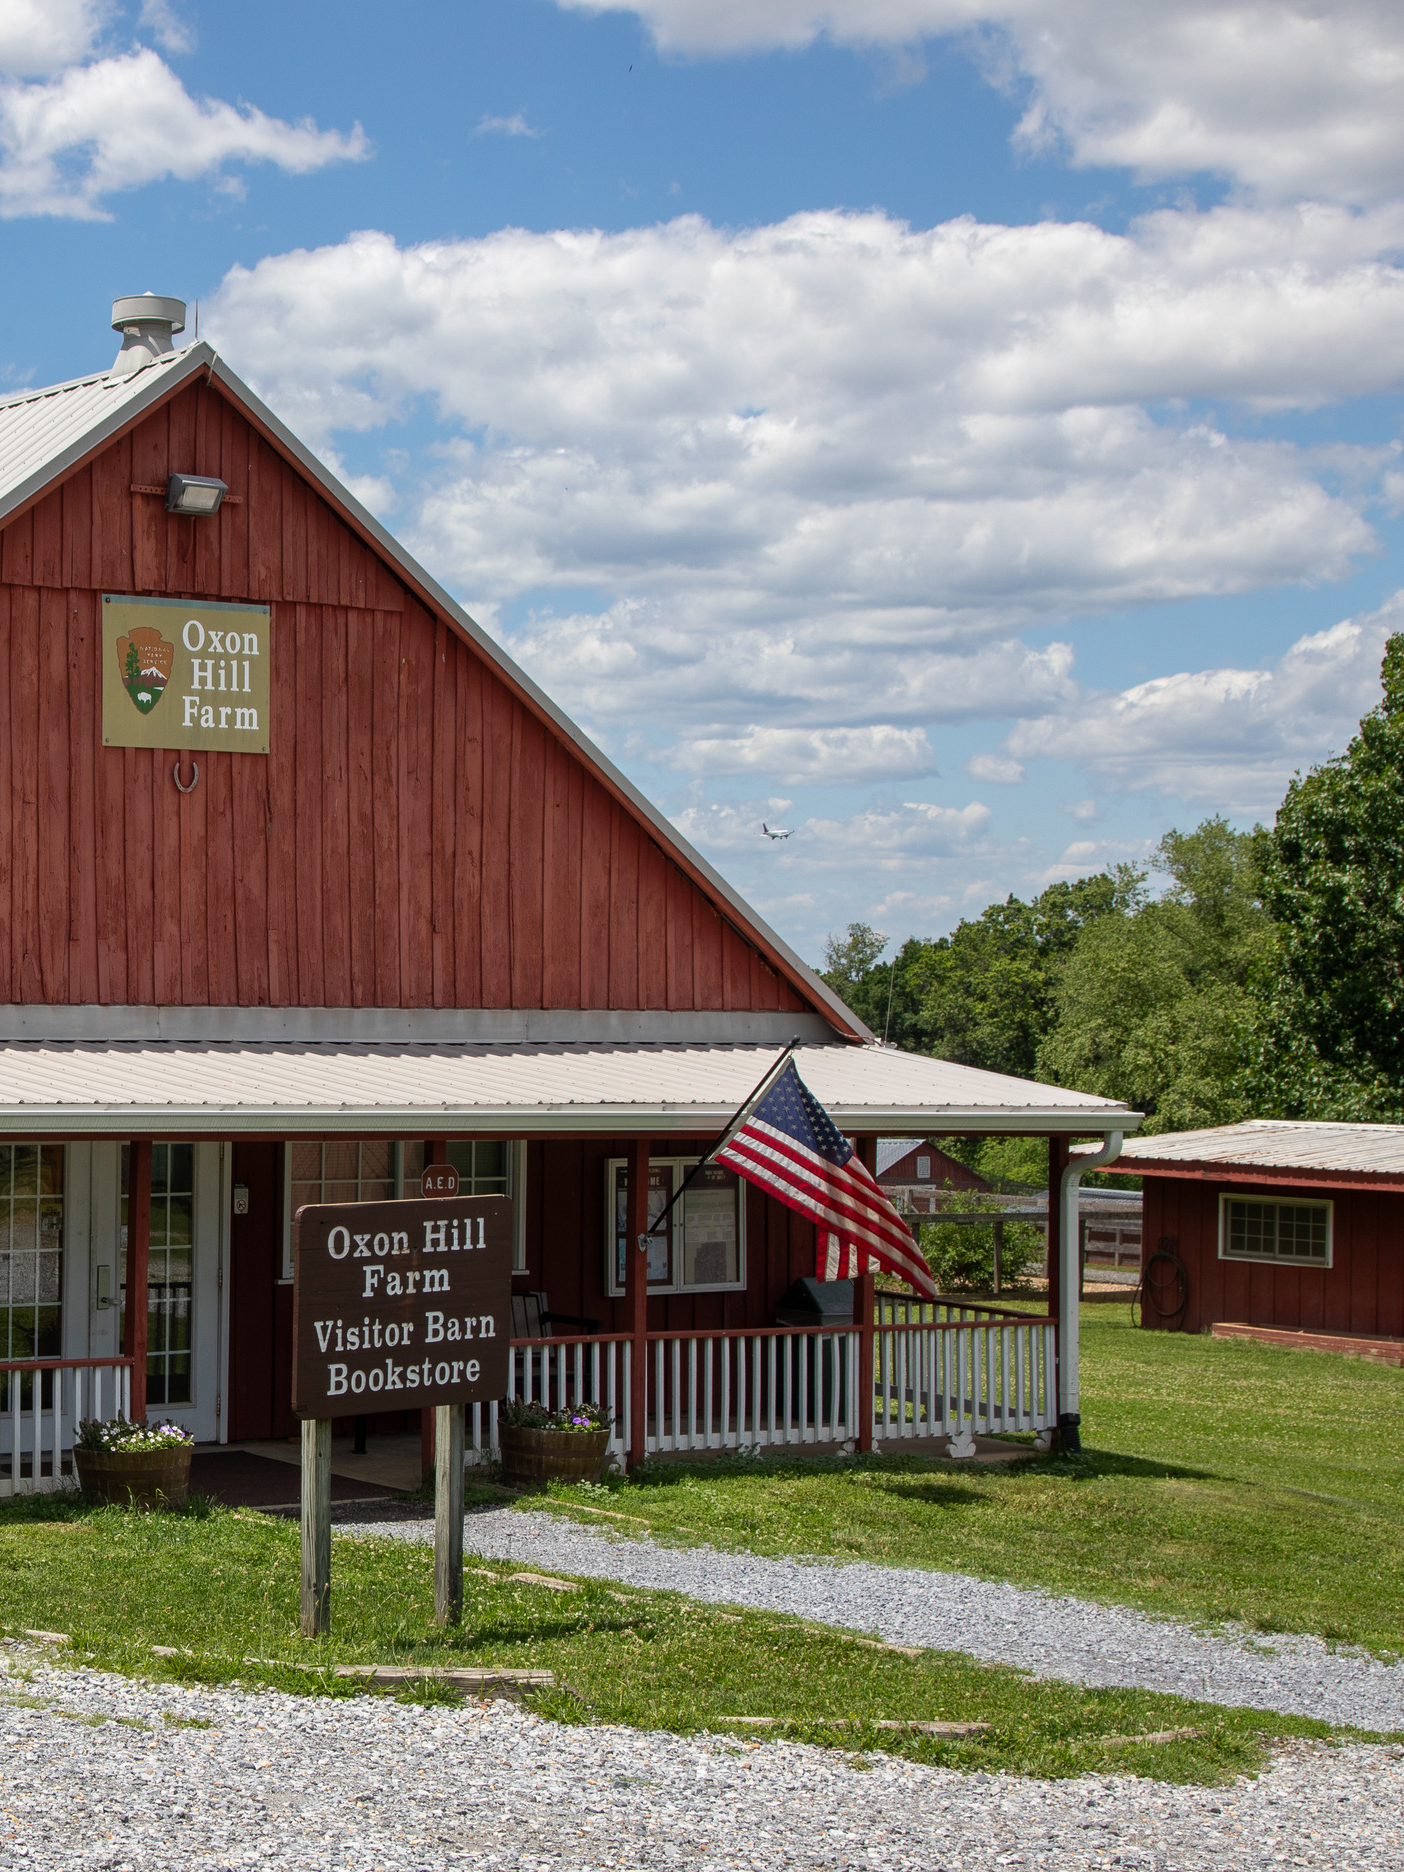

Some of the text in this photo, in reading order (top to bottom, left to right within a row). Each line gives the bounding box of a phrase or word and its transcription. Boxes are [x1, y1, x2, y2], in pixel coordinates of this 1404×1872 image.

[182, 619, 260, 656] Oxon
[190, 658, 252, 692] Hill
[181, 695, 260, 730] Farm
[425, 1176, 456, 1190] A.E.D
[327, 1217, 487, 1260] Oxon Hill
[362, 1264, 451, 1298] Farm
[314, 1310, 496, 1353] Visitor Barn
[326, 1356, 481, 1396] Bookstore
